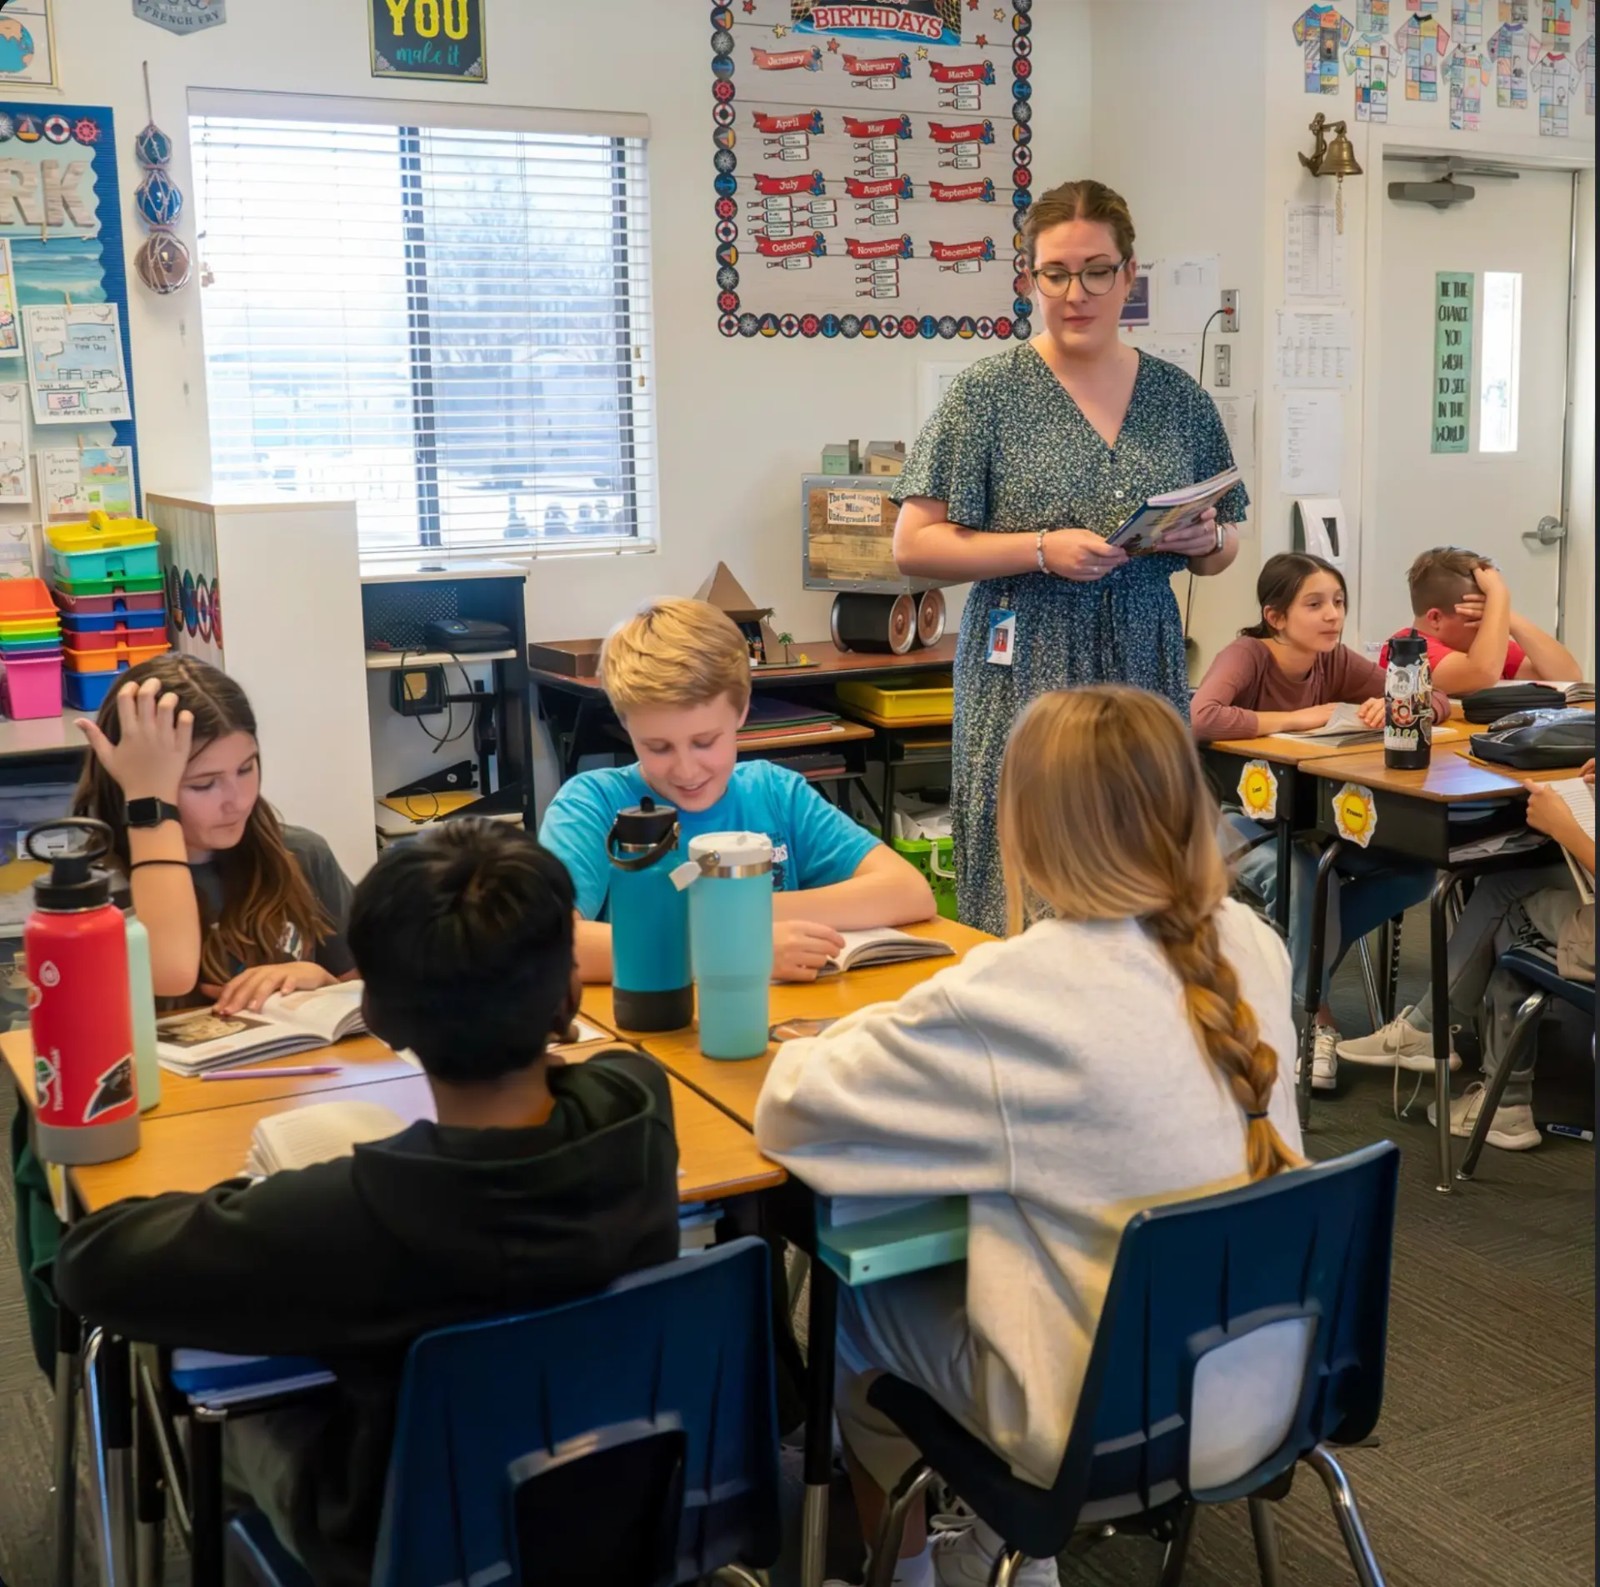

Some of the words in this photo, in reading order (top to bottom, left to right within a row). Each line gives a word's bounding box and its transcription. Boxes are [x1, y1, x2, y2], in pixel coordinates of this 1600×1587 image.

[144, 5, 194, 25] FRENCH
[198, 10, 220, 24] FRY
[385, 0, 470, 40] YOU
[811, 7, 943, 39] BIRTHDAYS
[396, 41, 442, 65] make
[447, 44, 461, 67] it
[767, 54, 805, 66] January
[855, 61, 896, 72] February
[947, 68, 975, 79] March
[775, 118, 800, 131] April
[867, 124, 885, 134] May
[950, 130, 971, 139] June
[779, 180, 799, 191] July
[863, 182, 893, 195] August
[938, 185, 983, 199] September
[771, 241, 807, 253] October
[857, 242, 900, 255] November
[941, 245, 983, 257] December
[1438, 304, 1468, 322] CHANGE
[1444, 329, 1463, 346] YOU
[1442, 353, 1463, 371] WISH
[1438, 377, 1449, 395] TO
[1438, 401, 1447, 418] IN
[1449, 401, 1465, 418] THE
[1435, 425, 1465, 442] WORLD
[829, 492, 841, 504] The
[845, 503, 864, 513] Mine
[829, 508, 866, 523] Underground
